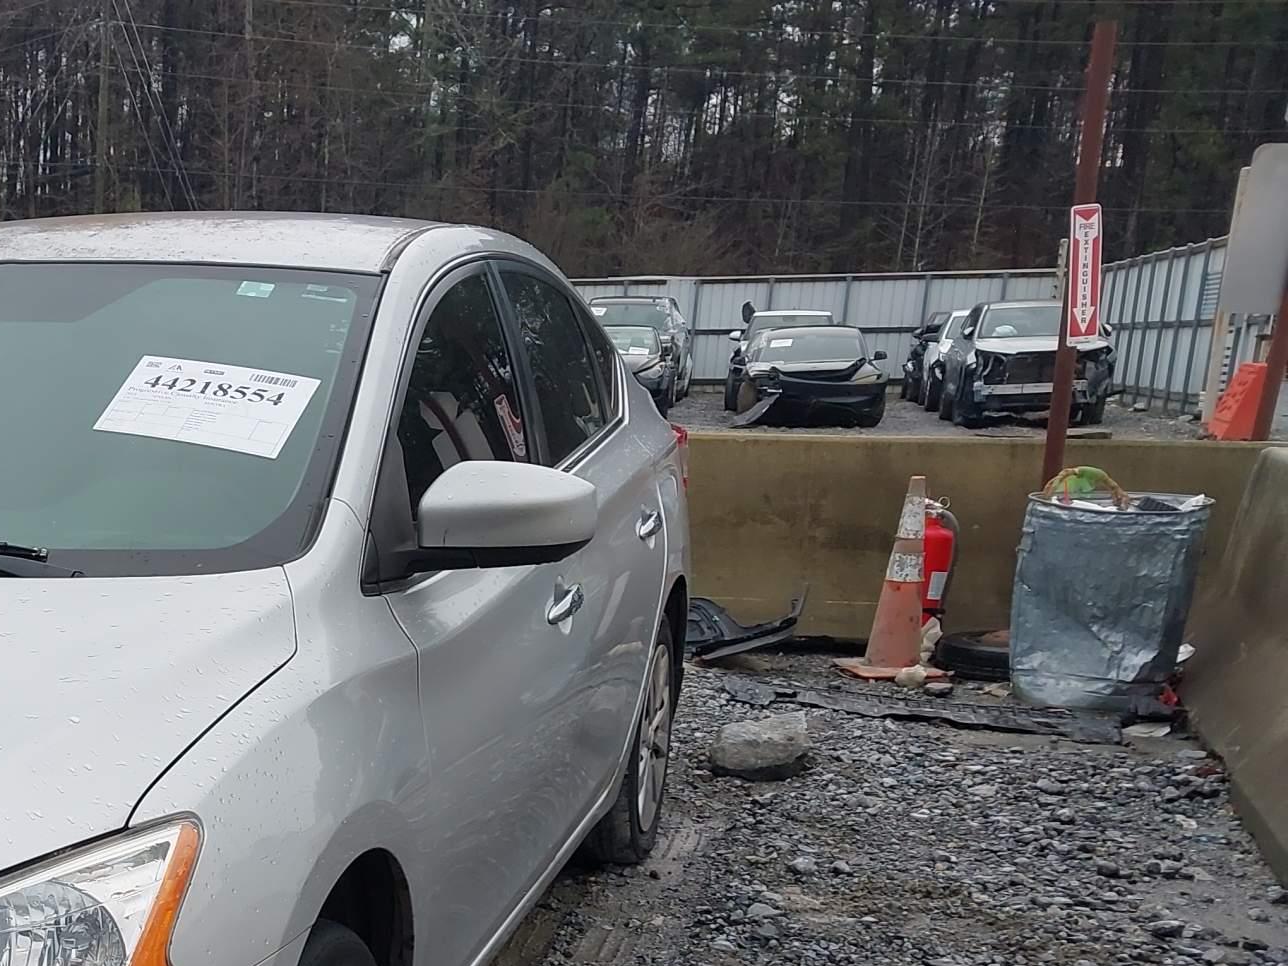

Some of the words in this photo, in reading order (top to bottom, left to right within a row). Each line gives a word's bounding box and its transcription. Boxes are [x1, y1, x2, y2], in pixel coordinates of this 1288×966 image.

[1079, 222, 1096, 231] FIRE
[1080, 231, 1090, 324] EXTINGUISHER
[144, 374, 285, 406] 44218554
